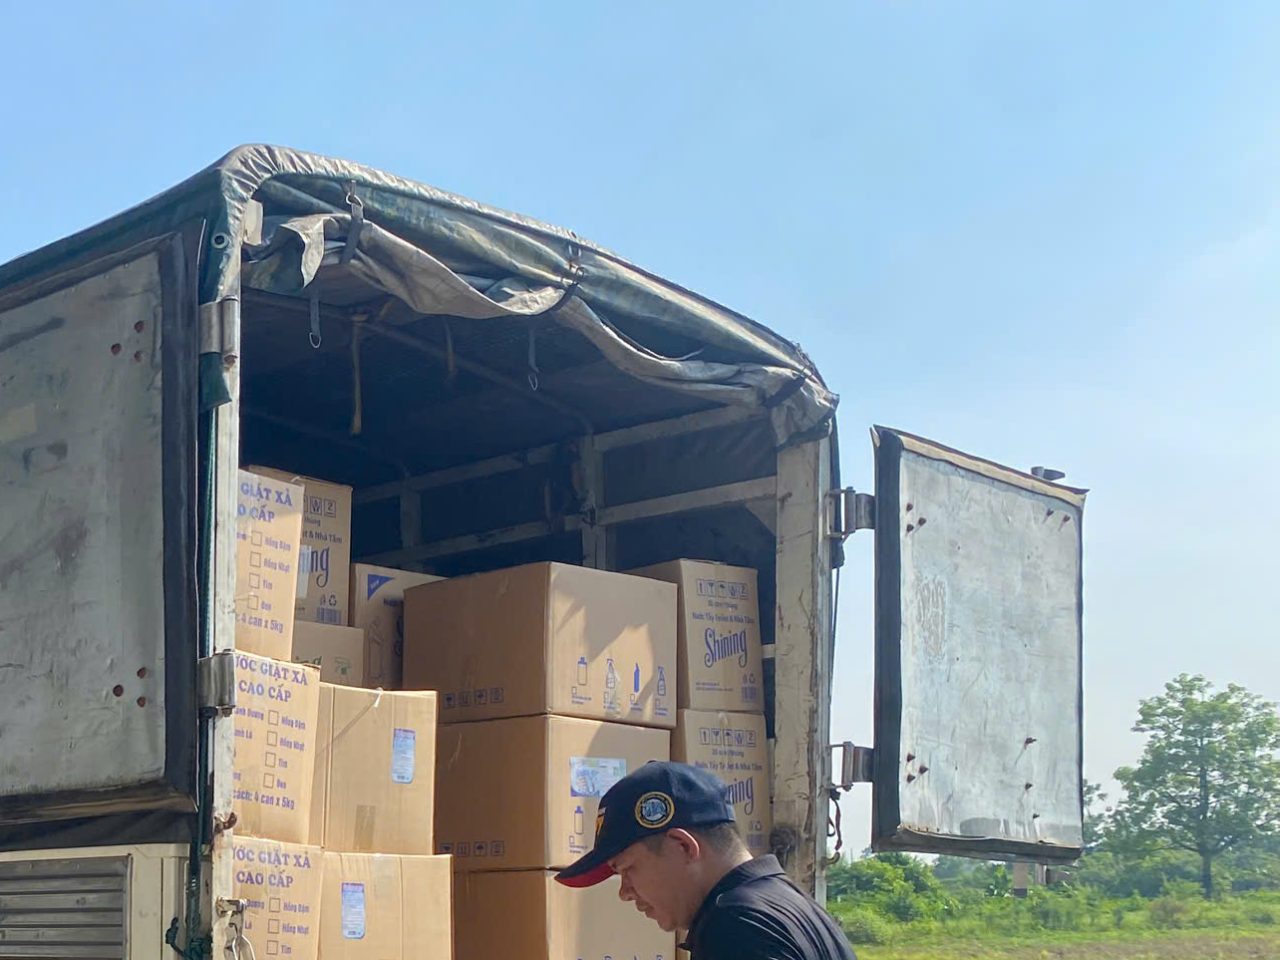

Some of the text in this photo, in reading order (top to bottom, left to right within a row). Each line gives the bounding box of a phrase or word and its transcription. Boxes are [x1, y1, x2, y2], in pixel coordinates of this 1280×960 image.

[250, 504, 275, 522] CẤP
[248, 616, 262, 628] can
[270, 619, 283, 634] 5kg
[704, 628, 748, 668] Shining
[239, 680, 291, 702] CAO CẤP
[261, 795, 274, 806] can
[282, 797, 294, 810] 5kg
[293, 850, 311, 869] XẢ
[236, 870, 293, 888] CAO CẤP
